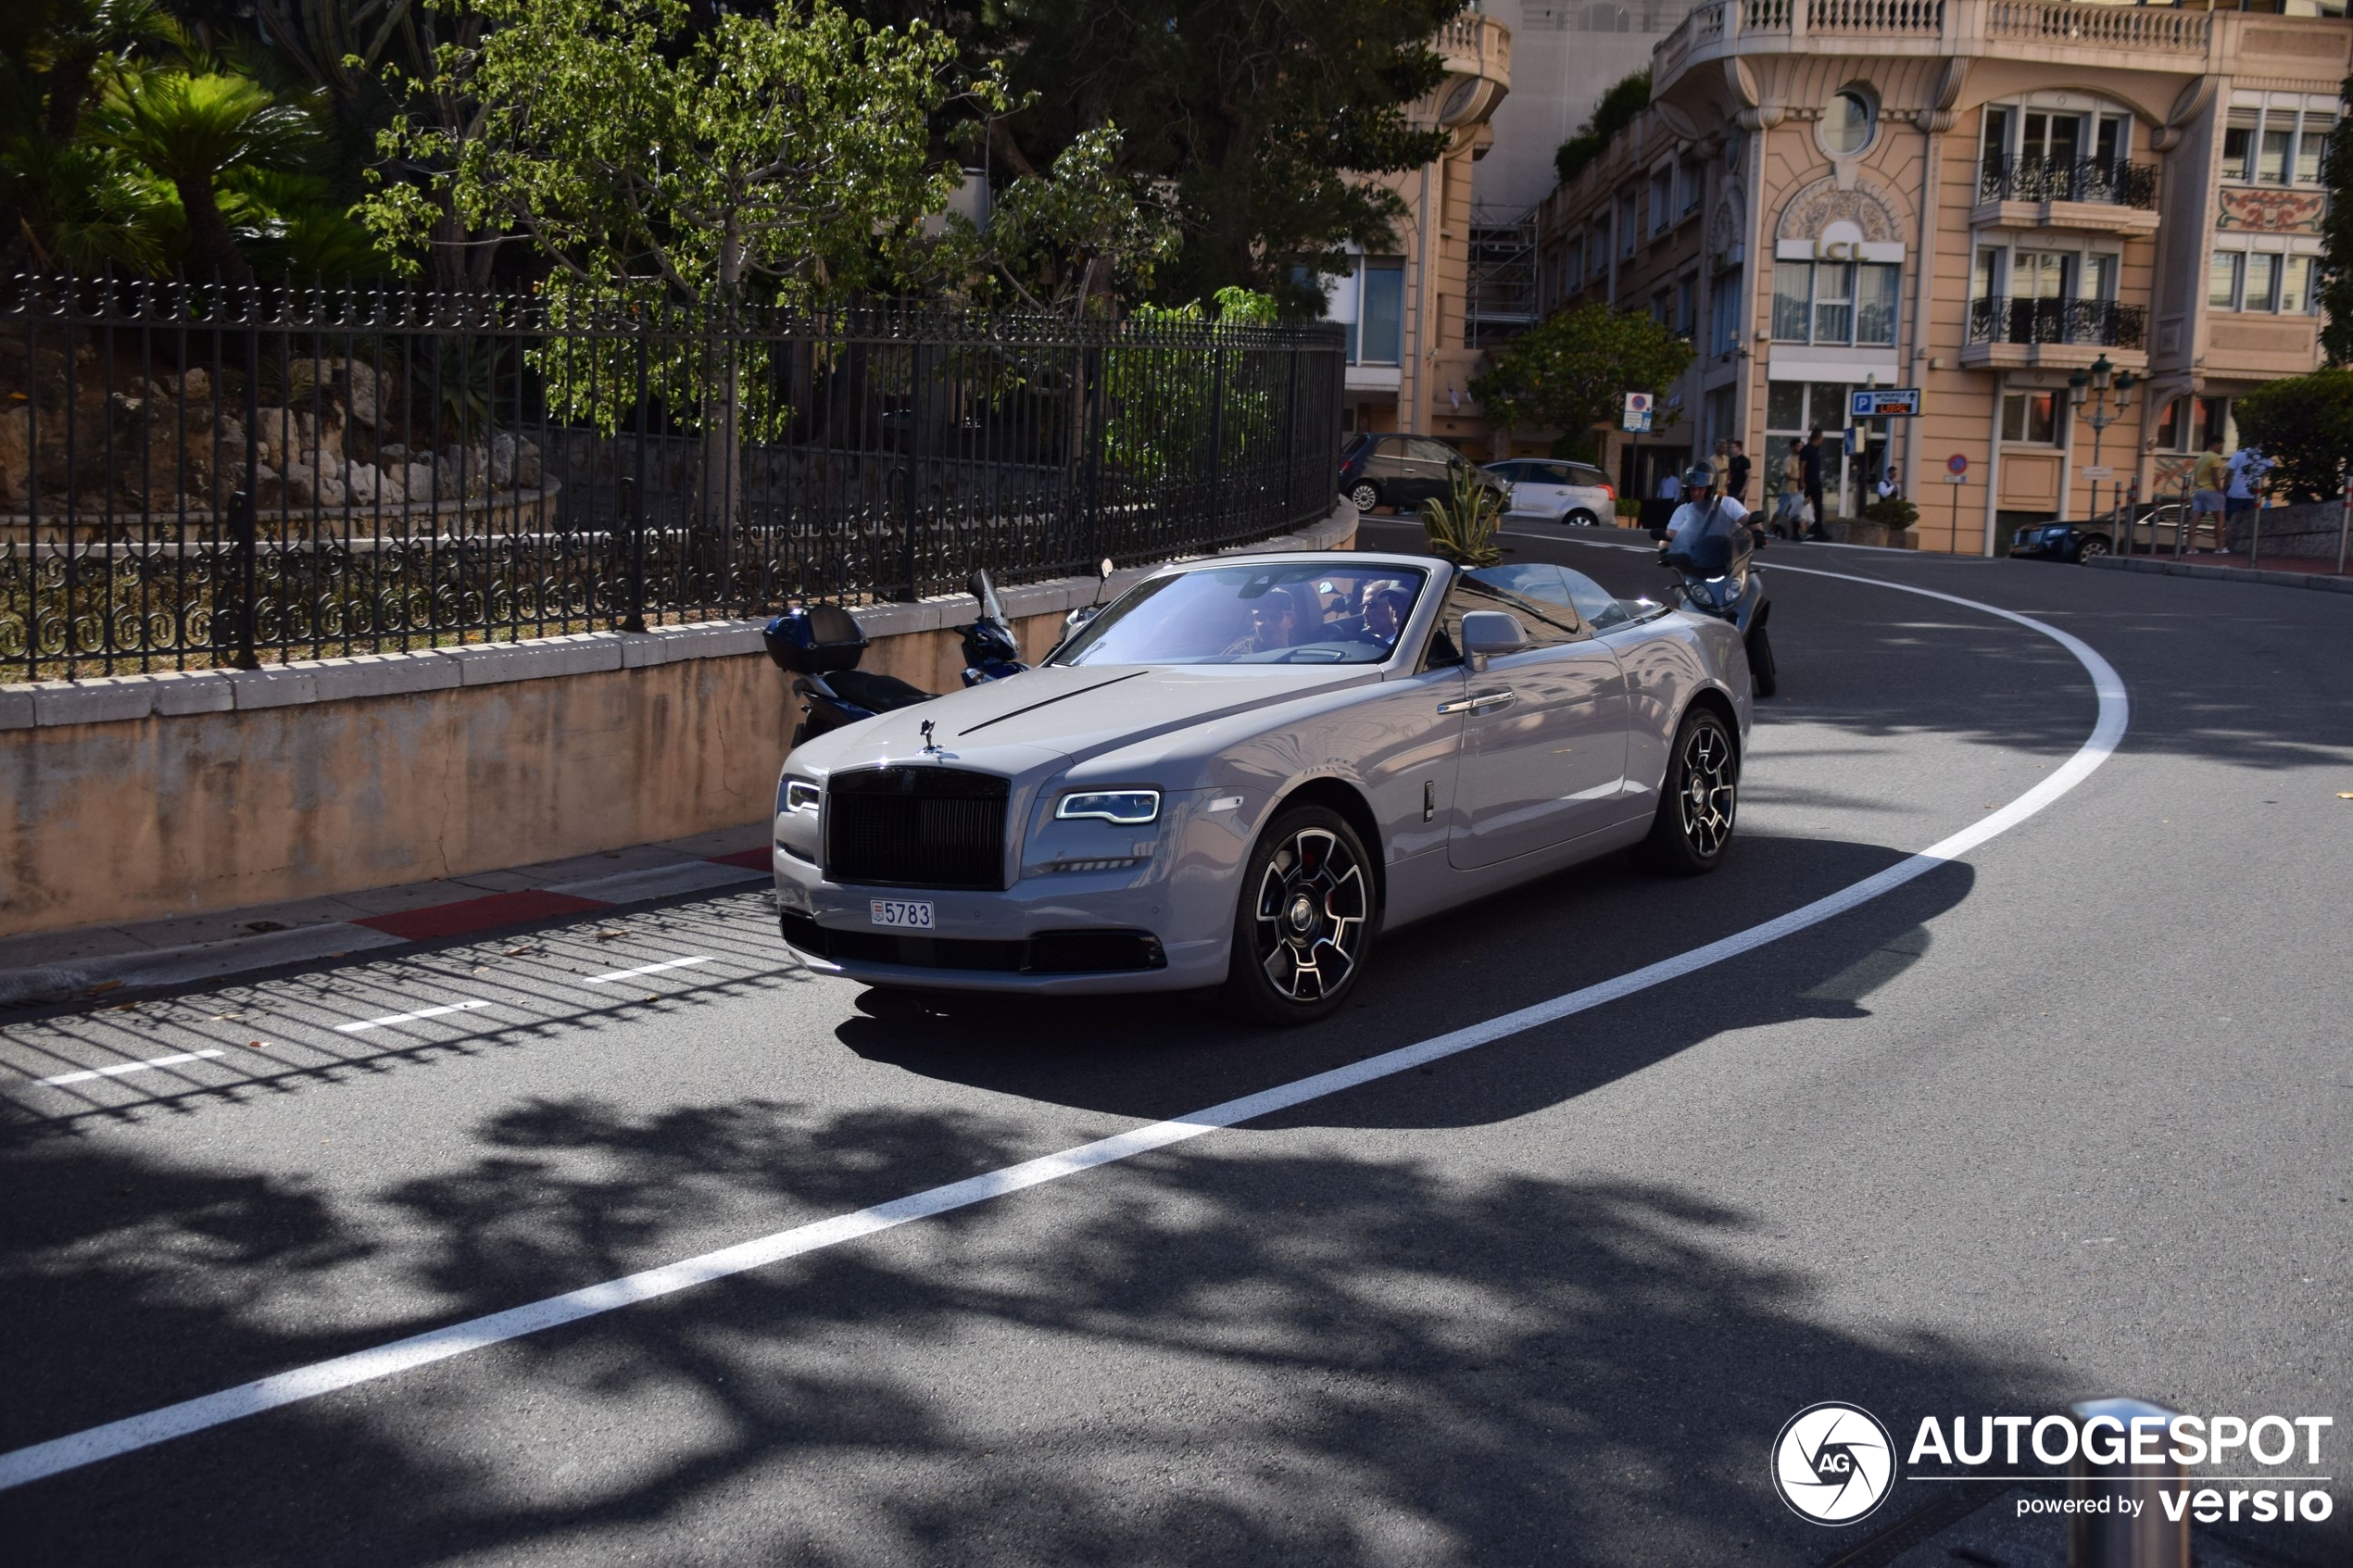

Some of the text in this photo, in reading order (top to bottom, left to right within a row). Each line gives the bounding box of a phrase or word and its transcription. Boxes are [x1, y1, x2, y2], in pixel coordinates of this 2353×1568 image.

[1813, 242, 1869, 261] LCL
[1858, 397, 1869, 409] P
[885, 903, 930, 925] 5783
